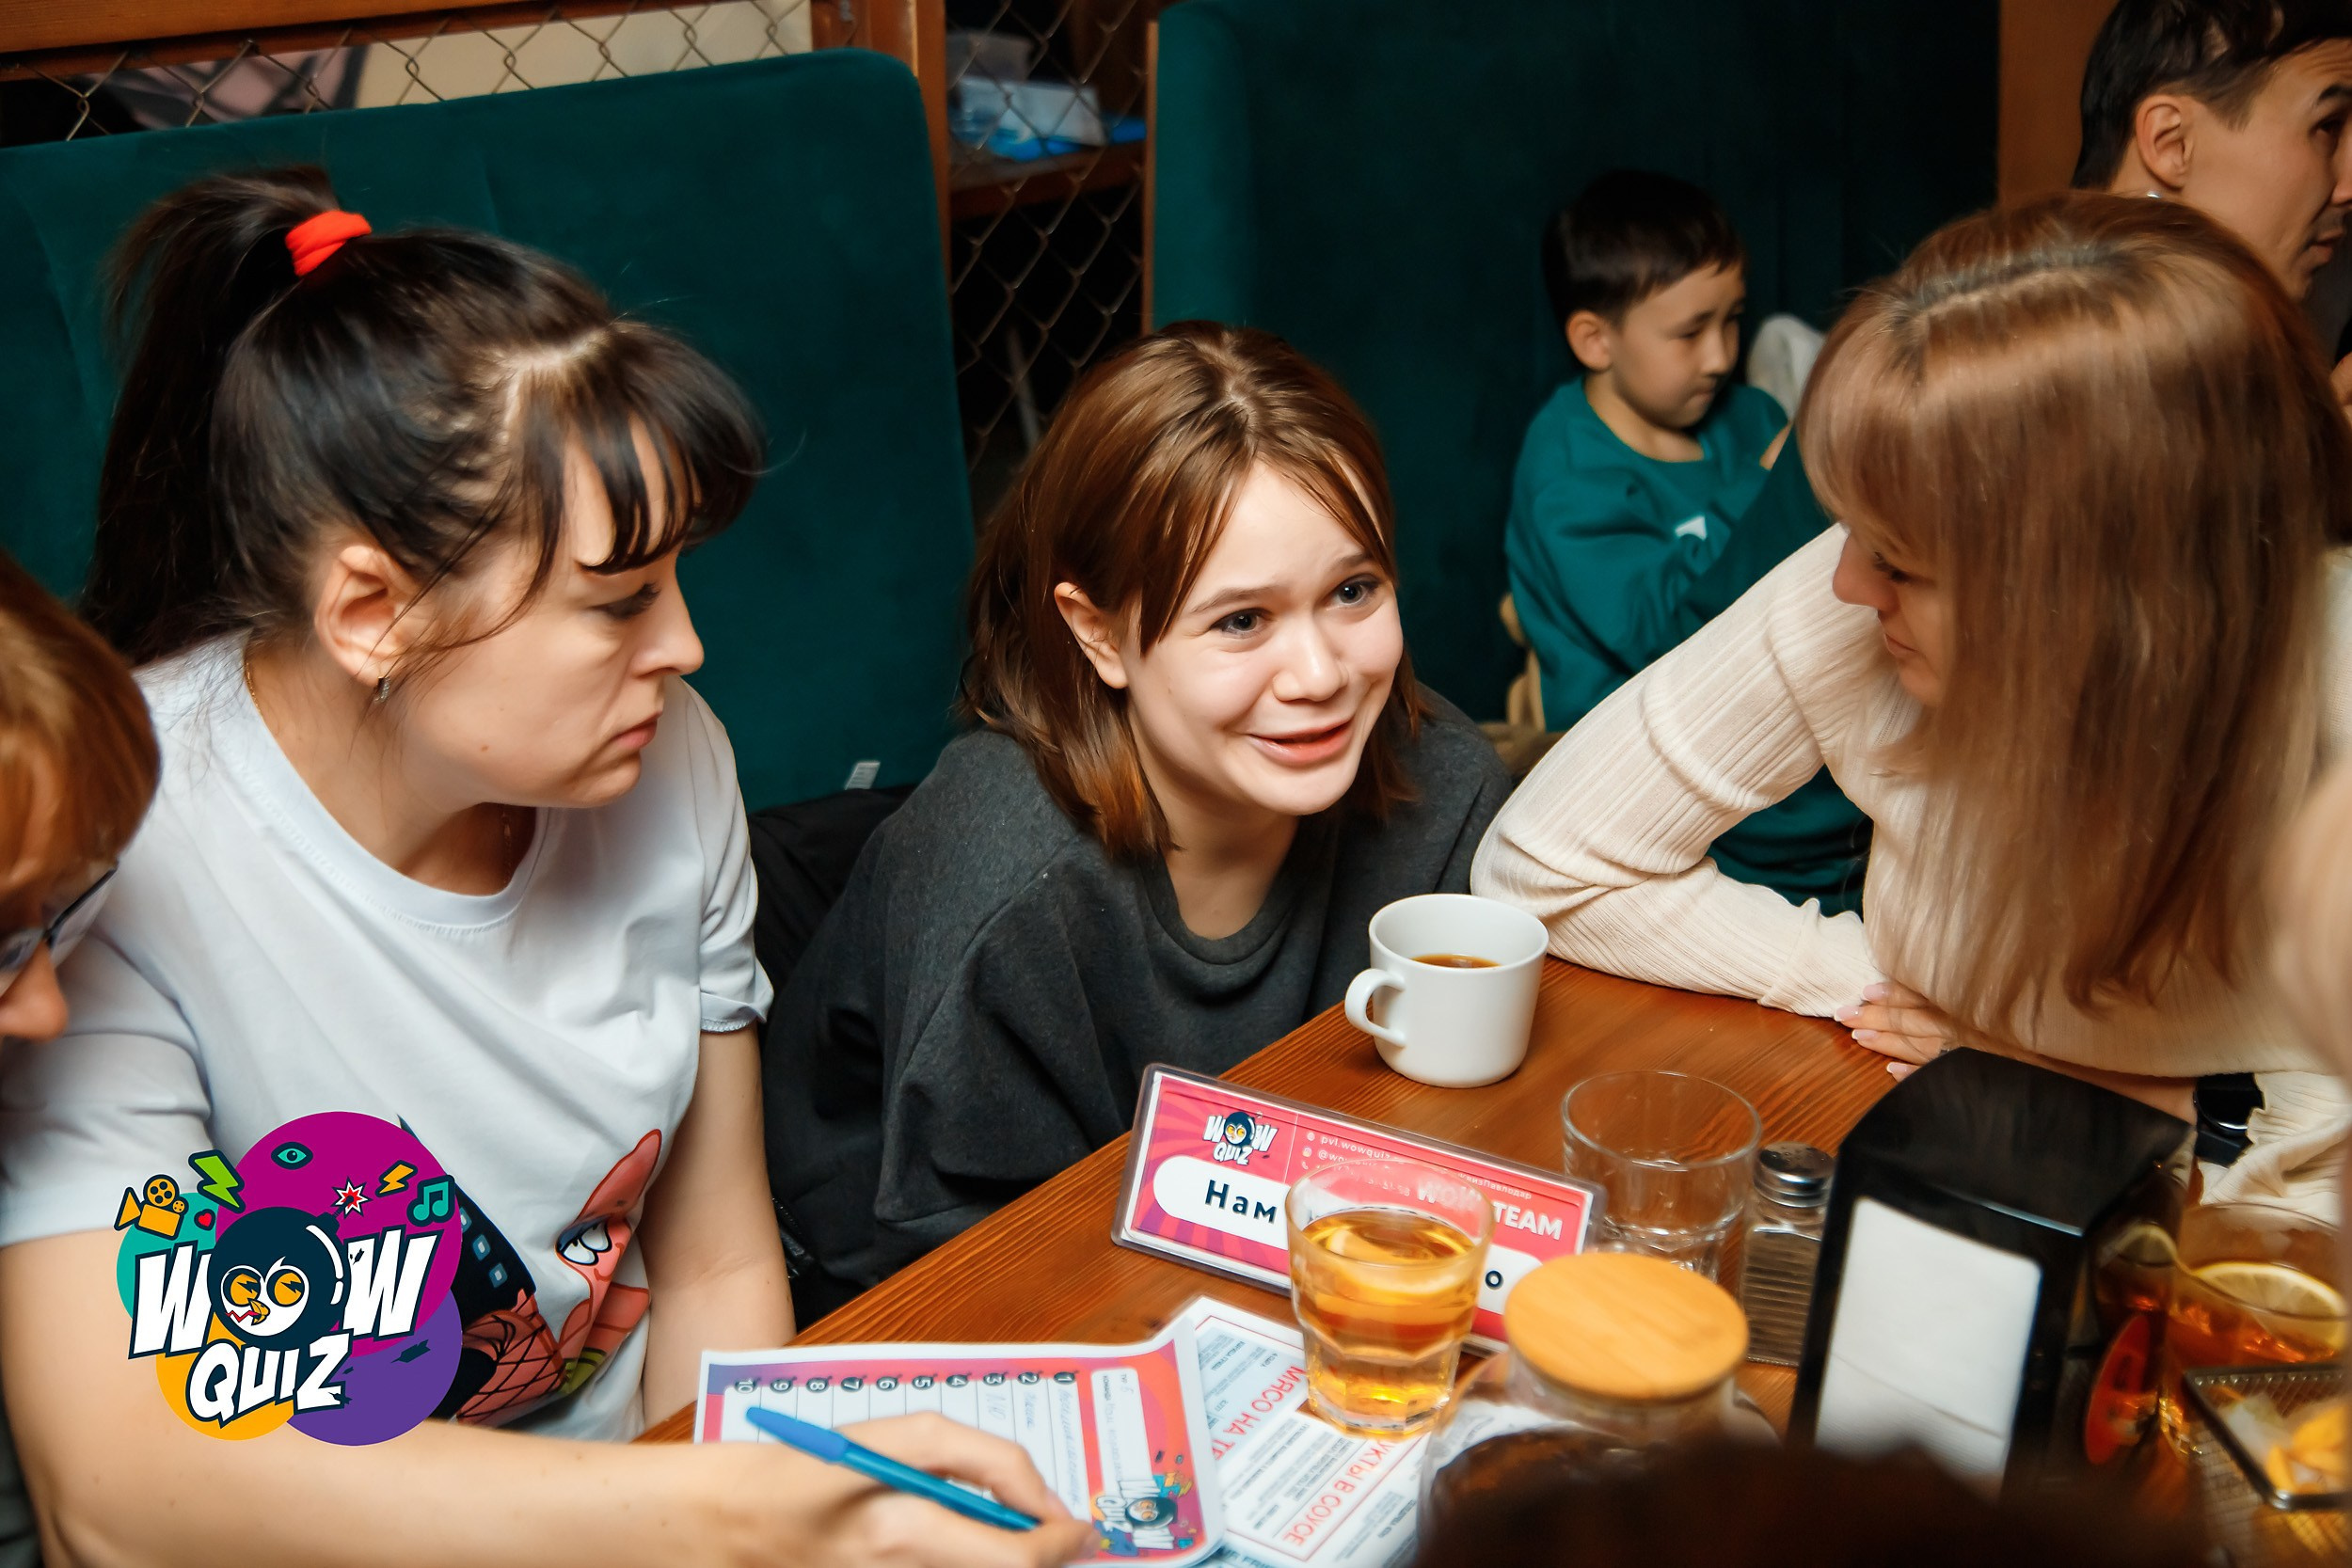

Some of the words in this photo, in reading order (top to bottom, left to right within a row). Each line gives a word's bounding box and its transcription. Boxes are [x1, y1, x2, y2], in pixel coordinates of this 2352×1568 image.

[1213, 1142, 1254, 1165] QUIZ
[1204, 1179, 1278, 1224] Нам
[1491, 1200, 1563, 1241] TEAM
[738, 1379, 753, 1393] 10
[1251, 1366, 1308, 1413] МЯСО
[1223, 1412, 1261, 1435] НА
[1282, 1494, 1341, 1545] СОУСЕ
